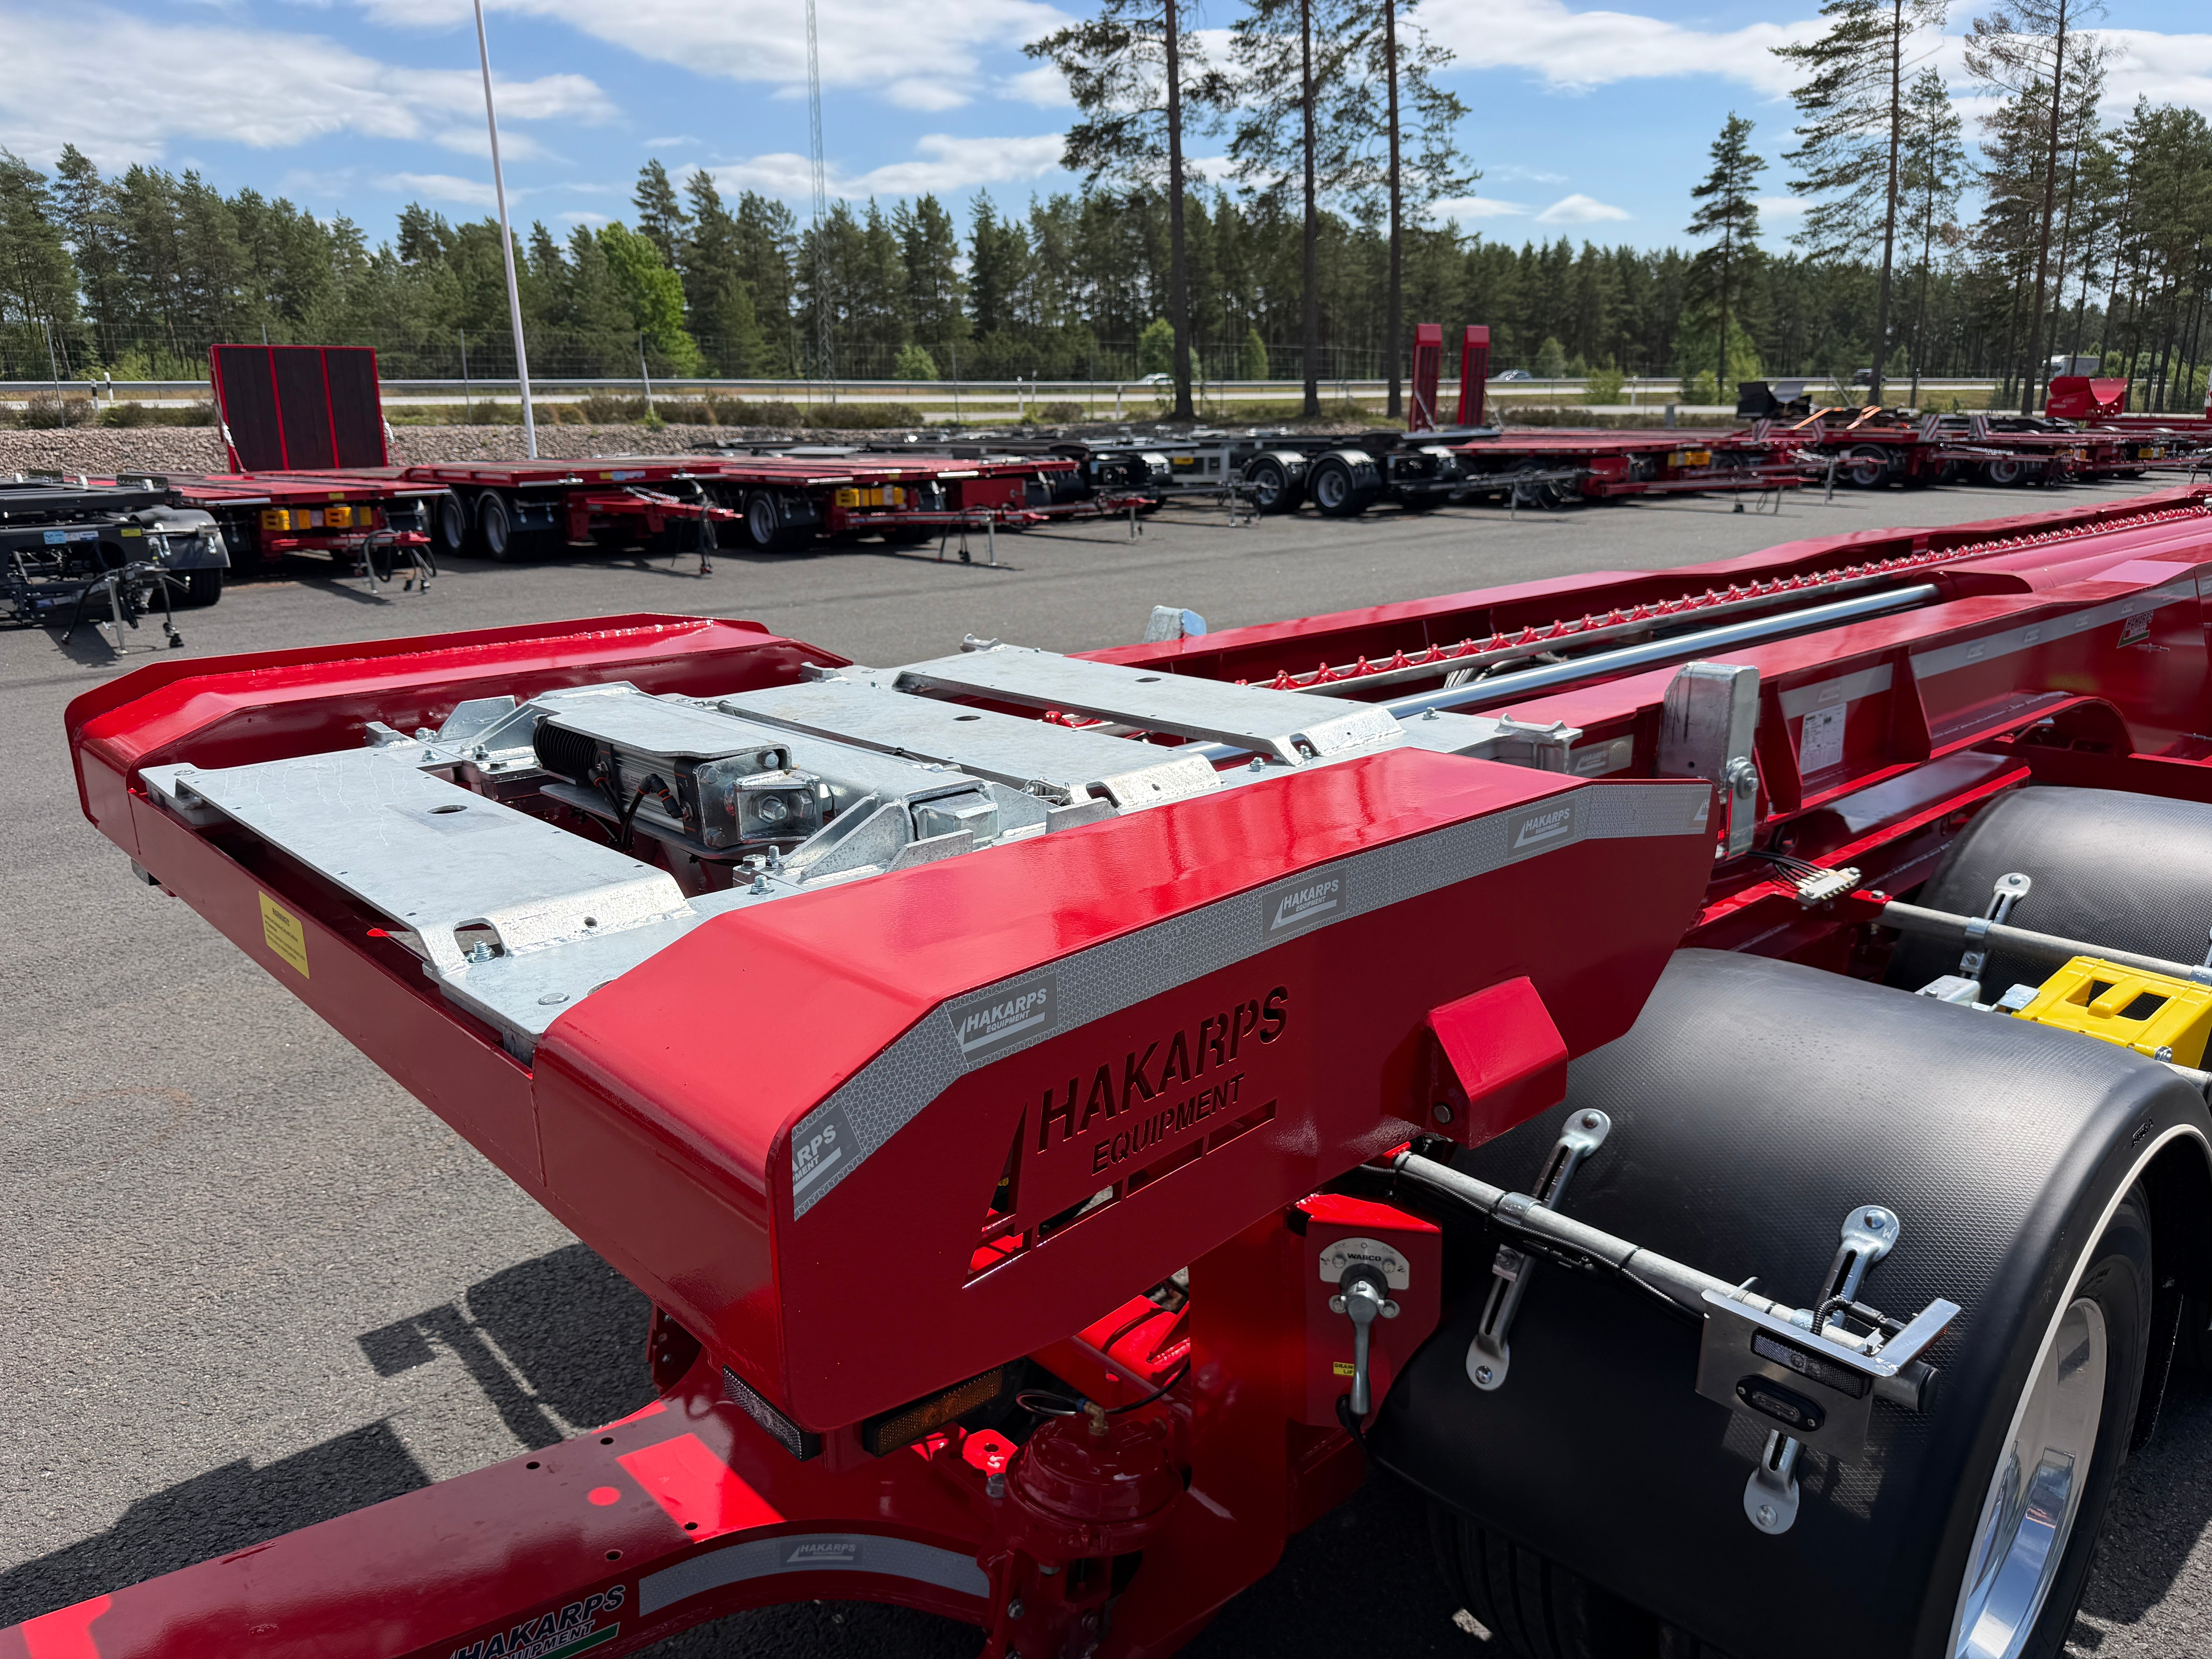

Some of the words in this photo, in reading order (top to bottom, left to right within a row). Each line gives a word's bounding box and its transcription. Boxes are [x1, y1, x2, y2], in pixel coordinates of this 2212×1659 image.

[1525, 808, 1570, 831] HAKARPS
[1283, 879, 1339, 909] HAKARPS
[1296, 896, 1326, 912] EQUIPMENT
[967, 988, 1046, 1032] HAKARPS
[986, 1010, 1030, 1033] EQUIPMENT
[1037, 986, 1288, 1154] HAKARPS
[1092, 1072, 1245, 1176] EQUIPMENT
[1347, 1253, 1381, 1261] WABCO
[800, 1543, 857, 1553] HAKARPS
[457, 1585, 626, 1659] HAKARPS
